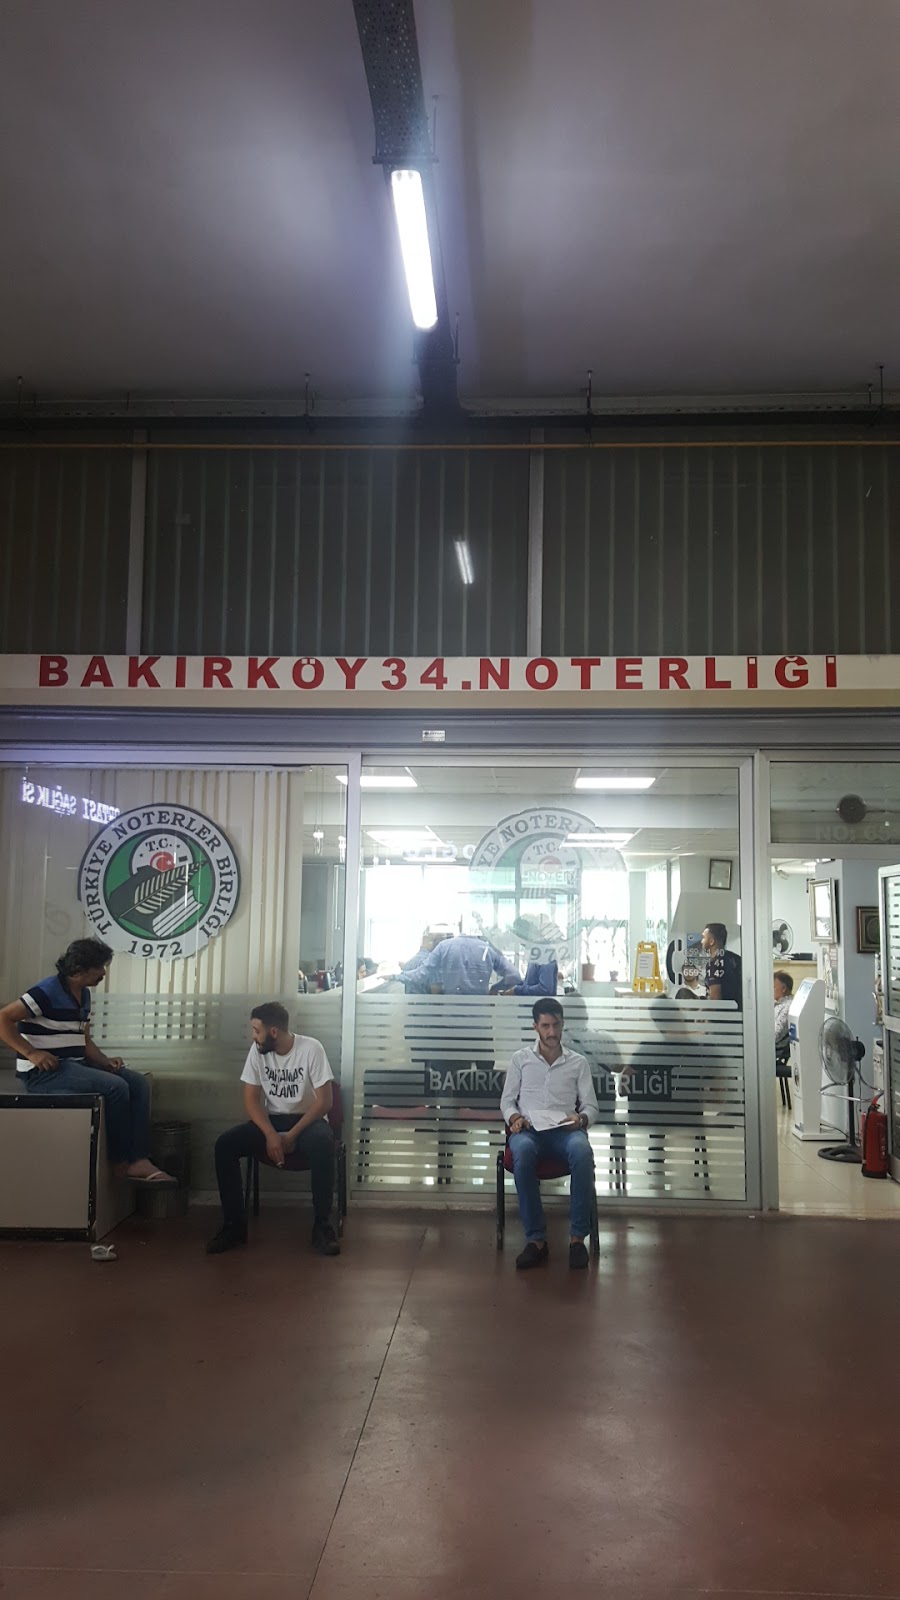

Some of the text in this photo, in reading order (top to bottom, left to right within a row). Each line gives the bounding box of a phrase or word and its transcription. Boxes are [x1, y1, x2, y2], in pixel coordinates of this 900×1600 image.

[84, 840, 113, 936] TÜRKİYE
[112, 810, 222, 853] NOTERLER
[128, 940, 183, 958] 1972
[521, 943, 571, 961] 972
[683, 968, 699, 976] 659
[714, 959, 724, 967] 41
[429, 1070, 668, 1095] BAKIRK TERLİĞİ
